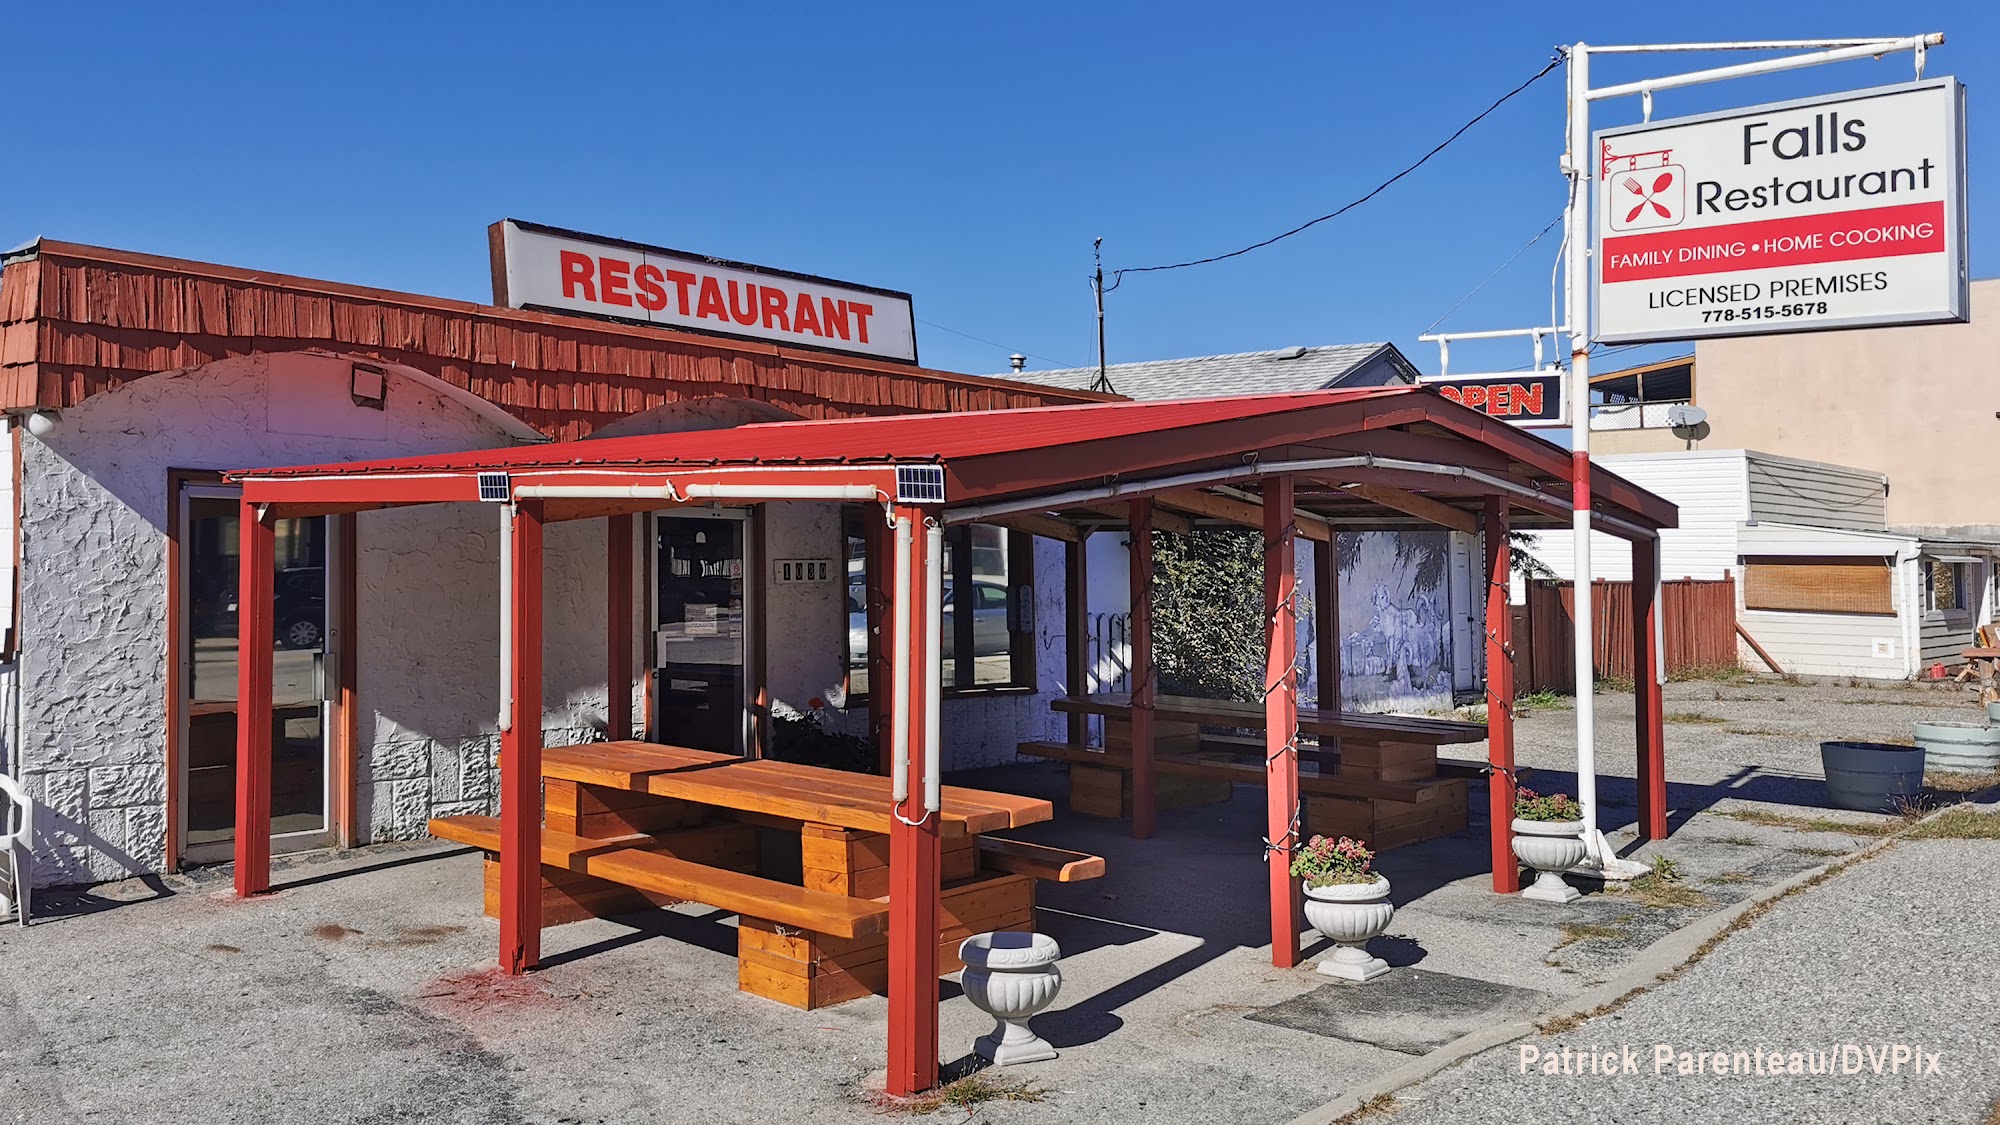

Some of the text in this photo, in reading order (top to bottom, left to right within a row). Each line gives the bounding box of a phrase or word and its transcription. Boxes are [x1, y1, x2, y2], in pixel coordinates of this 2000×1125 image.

[1743, 111, 1867, 165] Falls
[1696, 158, 1935, 215] Restaurant
[1610, 222, 1935, 269] FAMILY DINING HOME COOKING
[559, 250, 873, 344] RESTAURANT
[1649, 271, 1888, 309] LICENSED PREMISES
[1701, 301, 1828, 324] 778-515-5678
[783, 563, 827, 580] 1030
